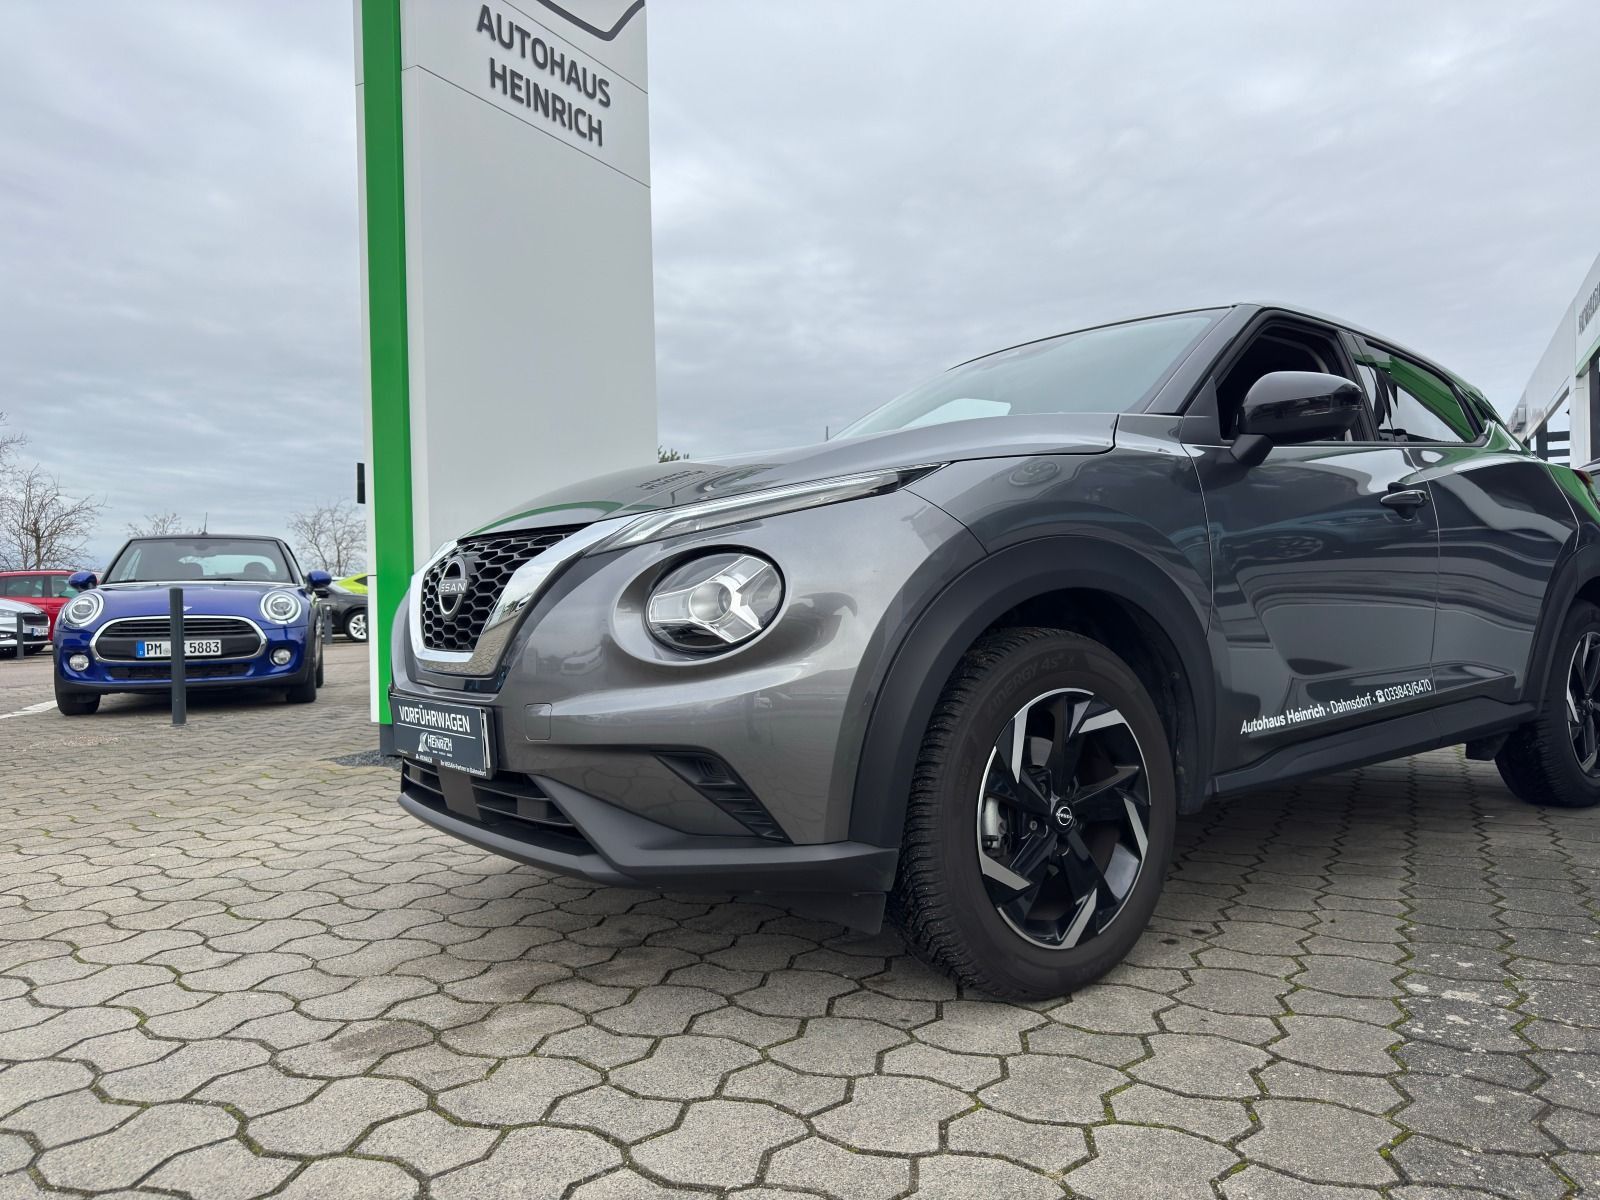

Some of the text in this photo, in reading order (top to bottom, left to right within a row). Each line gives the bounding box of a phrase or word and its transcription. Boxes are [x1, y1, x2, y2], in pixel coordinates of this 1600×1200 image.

[477, 4, 611, 108] AUTOHAUS
[489, 57, 603, 147] HEINRICH
[146, 641, 220, 655] PM 5883
[398, 705, 471, 733] VORFÜHRWAGEN
[1240, 678, 1432, 735] Autohaus Heinrich Dahnsdorf 033843/6470
[427, 734, 453, 752] HEINRICH
